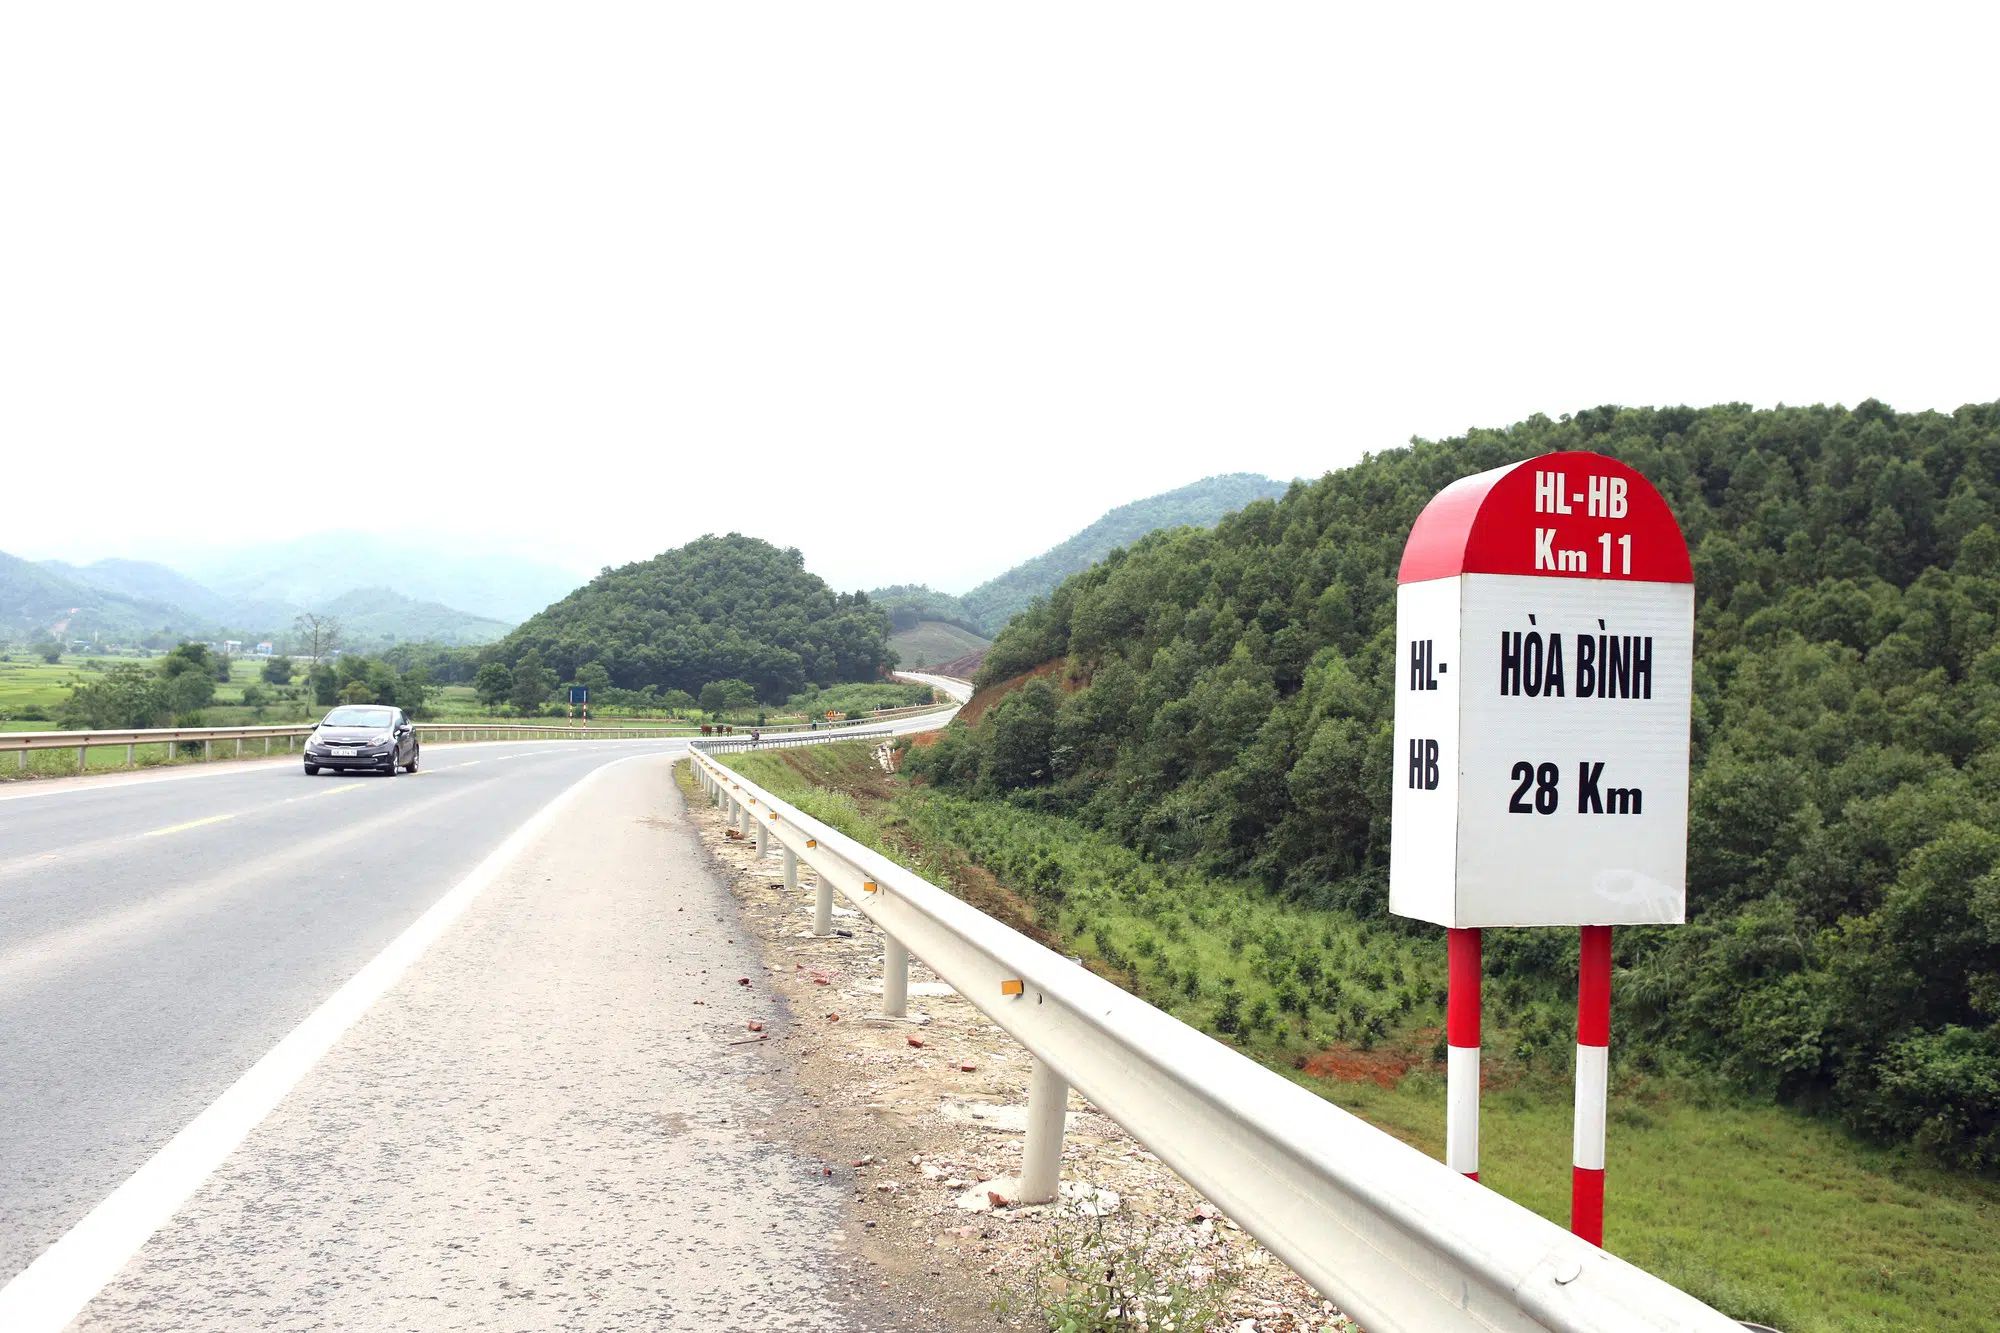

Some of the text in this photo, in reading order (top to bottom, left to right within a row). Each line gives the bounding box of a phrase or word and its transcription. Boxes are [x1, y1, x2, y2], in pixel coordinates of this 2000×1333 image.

[1535, 470, 1628, 519] HL-HB
[1535, 527, 1631, 575] Km 11
[1410, 639, 1447, 691] HL-
[1501, 614, 1653, 699] HÒA BÌNH
[1409, 738, 1440, 791] HB
[1509, 761, 1643, 816] 28 Km
